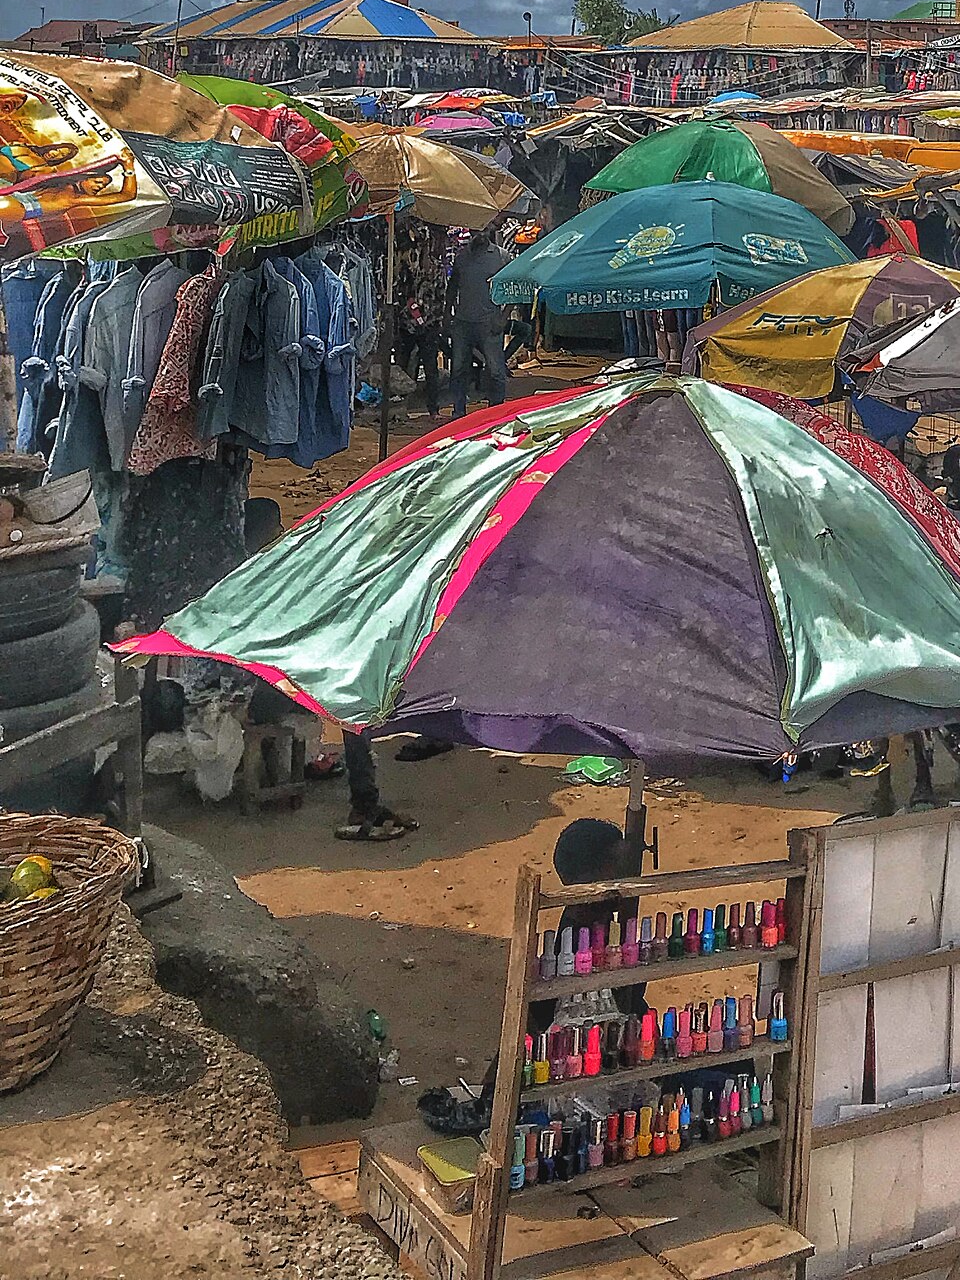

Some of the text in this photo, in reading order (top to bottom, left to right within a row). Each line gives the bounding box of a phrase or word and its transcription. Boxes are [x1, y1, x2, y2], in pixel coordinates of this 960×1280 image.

[87, 116, 113, 142] CLUB
[566, 288, 689, 307] Help Kids Learn
